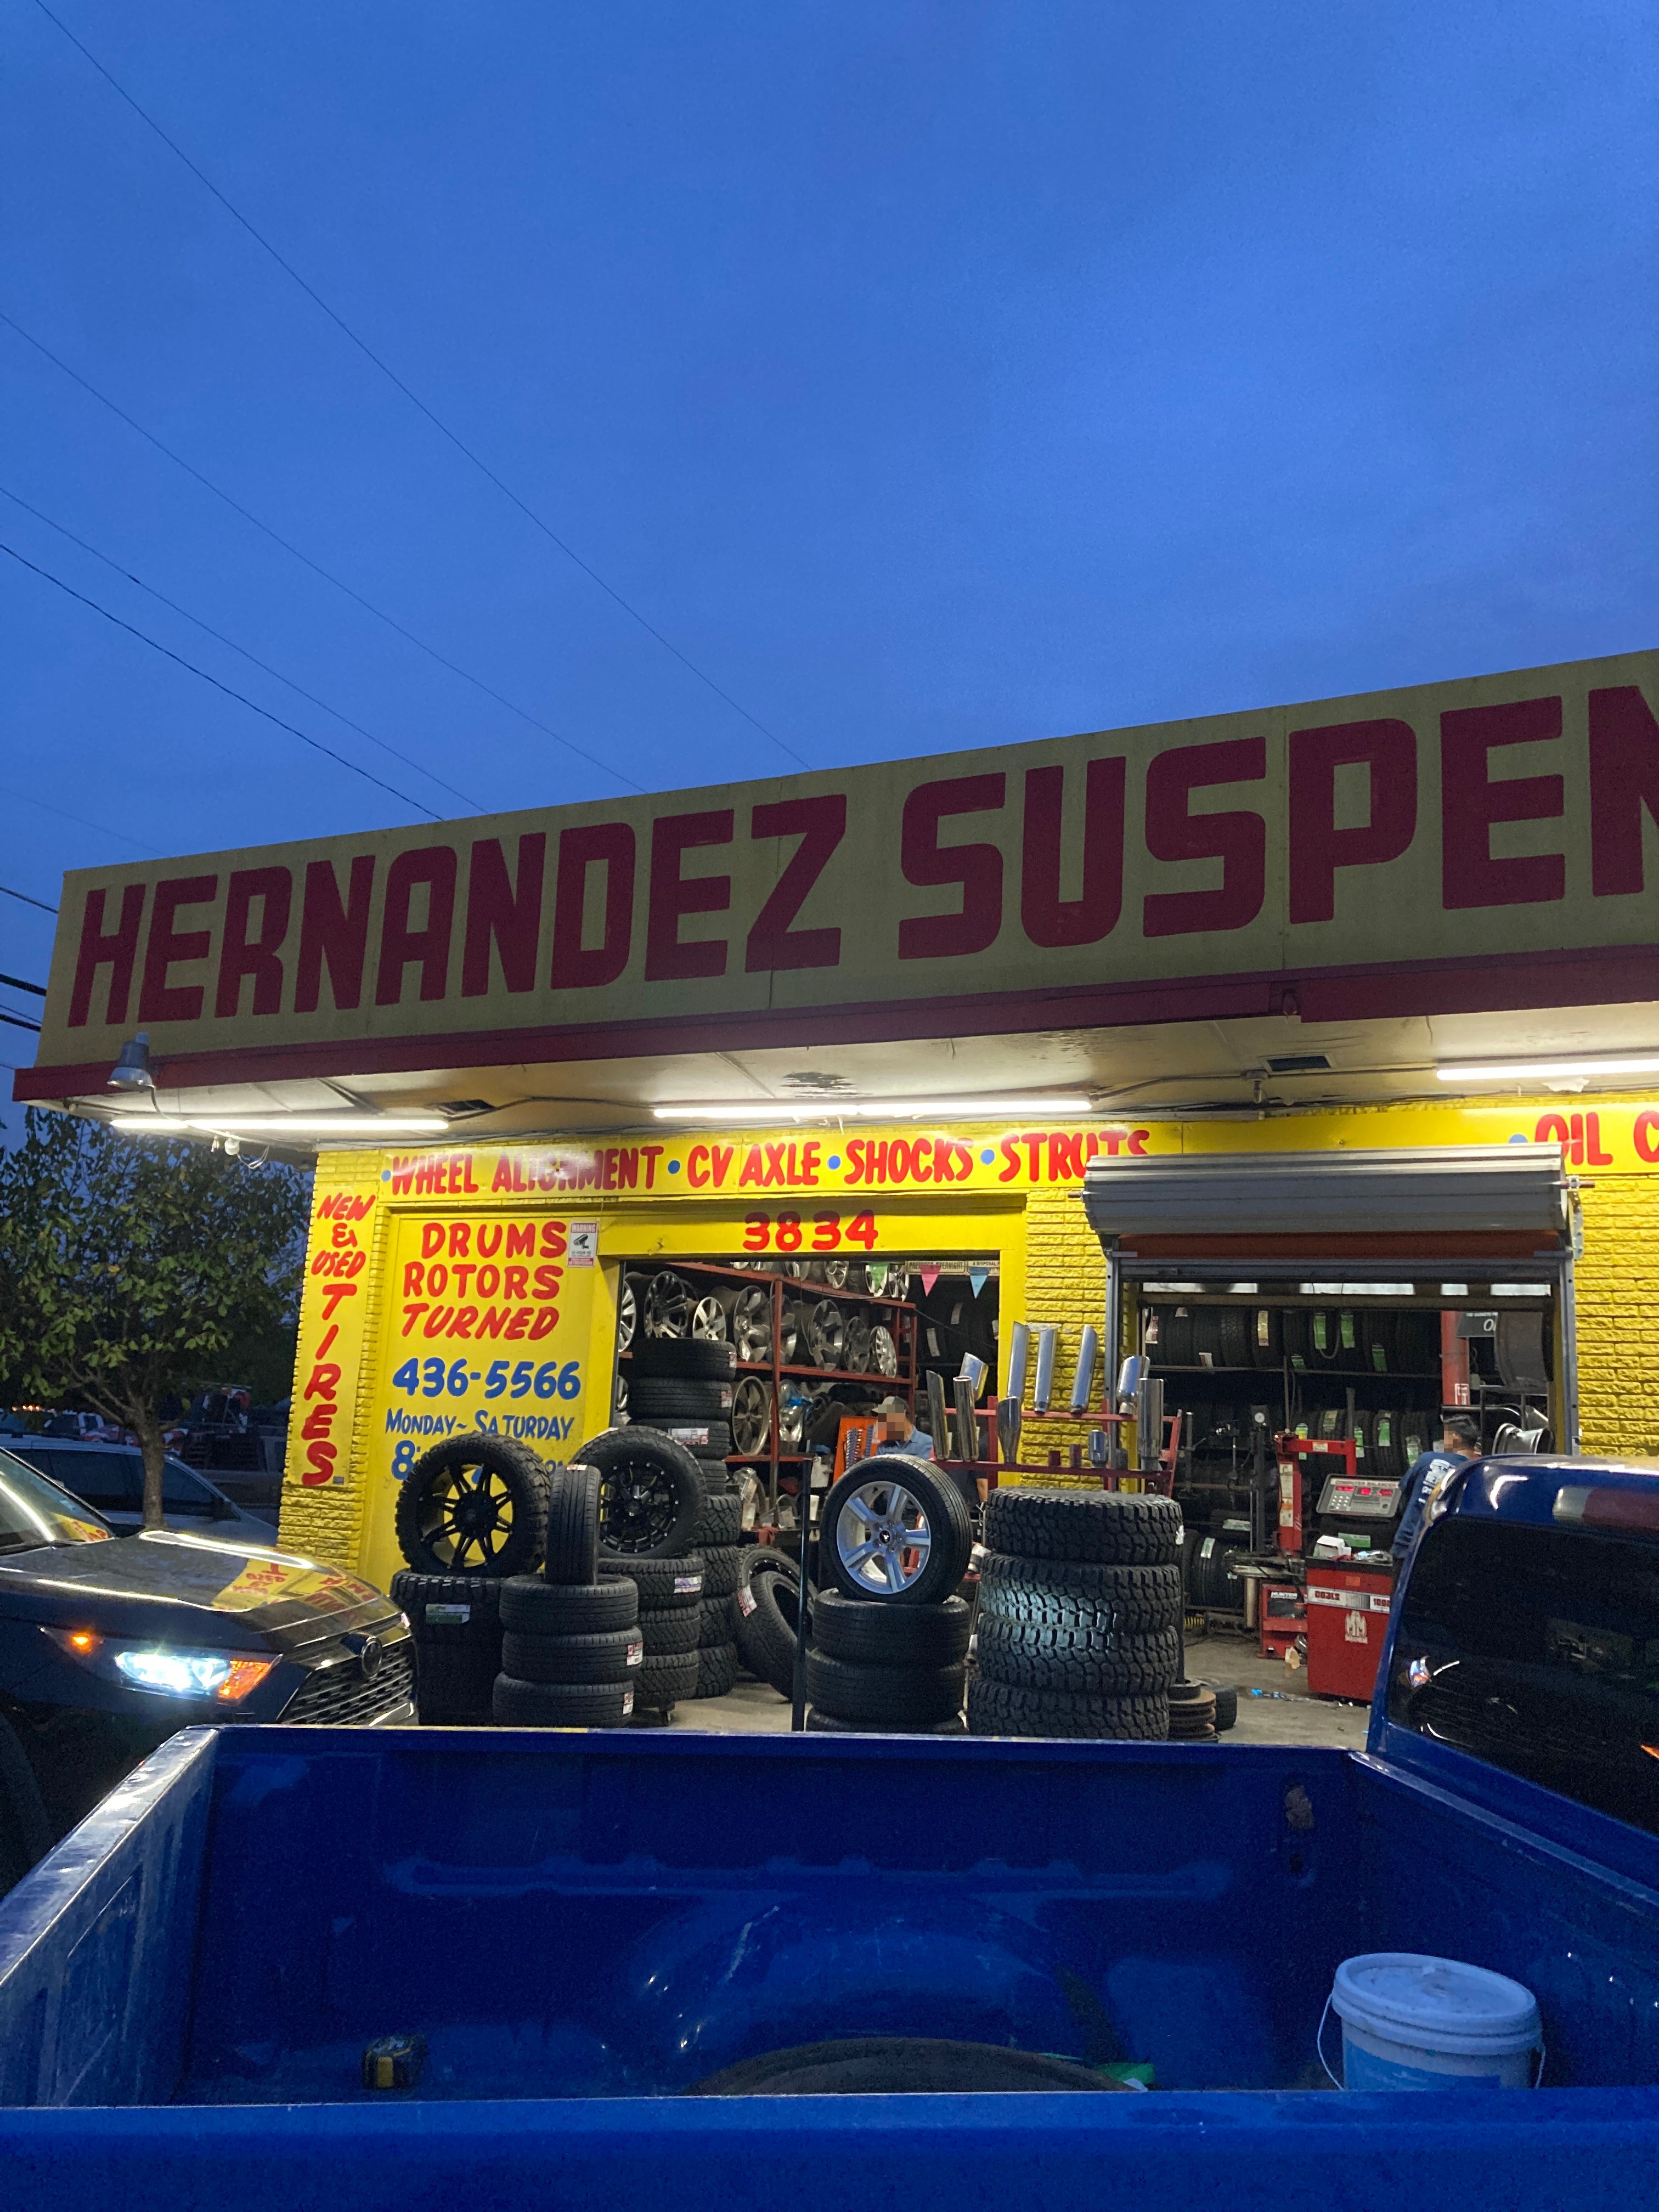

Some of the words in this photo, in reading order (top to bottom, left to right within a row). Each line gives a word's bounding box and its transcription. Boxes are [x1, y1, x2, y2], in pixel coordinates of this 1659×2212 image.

[67, 794, 847, 1028] HERNANDEZ
[1536, 1112, 1612, 1165] OIL
[392, 1153, 478, 1195] WHEEL
[492, 1146, 664, 1192] ALIGNMENT
[687, 1146, 733, 1188] CV
[740, 1142, 821, 1187] AXLE
[844, 1138, 974, 1184] SHOCKS
[317, 1193, 375, 1221] NEW
[421, 1221, 567, 1259] DRUMS
[571, 1224, 596, 1233] WARNING
[742, 1209, 878, 1252] 3834
[311, 1250, 366, 1278] USED
[403, 1261, 564, 1300] ROTORS
[401, 1303, 560, 1340] TURNED
[392, 1357, 581, 1400] 436-5566
[475, 1409, 575, 1441] SATURDAY
